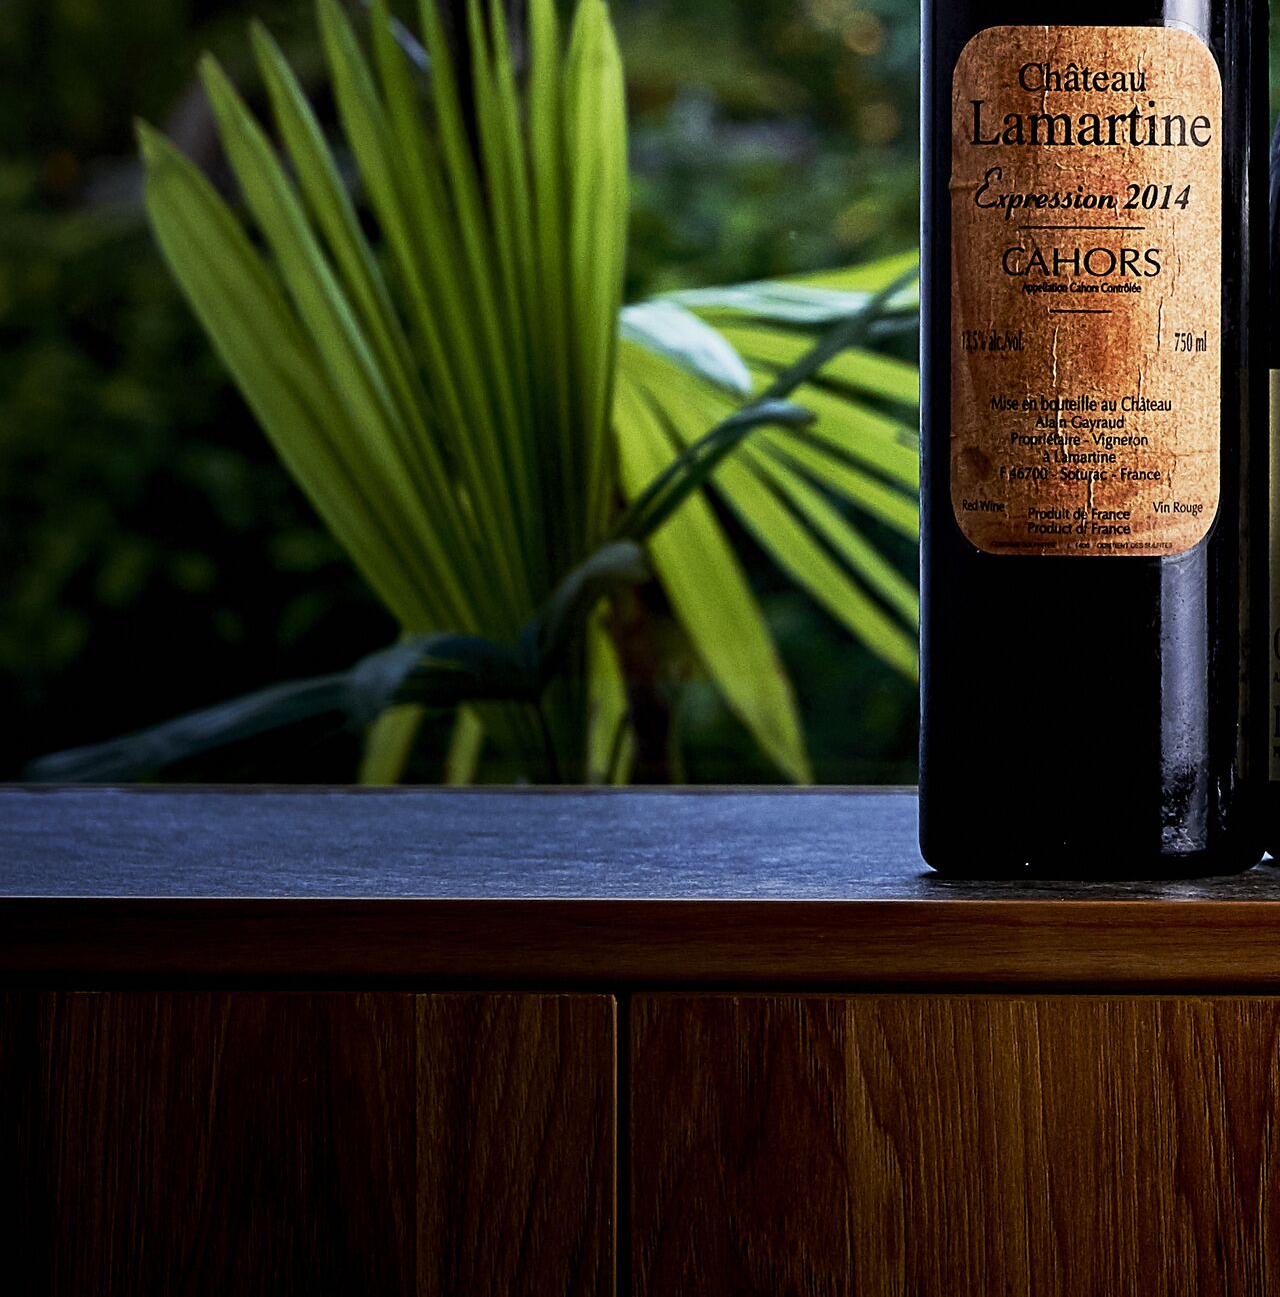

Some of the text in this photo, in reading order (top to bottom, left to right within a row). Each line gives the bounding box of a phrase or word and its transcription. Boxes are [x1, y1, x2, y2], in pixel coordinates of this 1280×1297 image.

[1019, 63, 1146, 92] Château
[970, 100, 1211, 146] Lamartine
[975, 167, 1191, 219] Expression 2014
[1002, 247, 1161, 277] CAHORS
[1022, 283, 1141, 294] Appellation Cahors Contrôlée
[1175, 331, 1207, 352] 750 ml
[992, 395, 1172, 411] Mise en bouteille au Château
[1036, 416, 1124, 431] Alain Gayraud
[1011, 433, 1081, 448] Propriétaire
[1092, 433, 1148, 448] Vigneron
[1043, 452, 1116, 463] à Lamartine
[1000, 469, 1006, 479] F
[1009, 469, 1047, 480] 46700
[1060, 469, 1107, 480] Soturac
[1120, 468, 1161, 480] France
[963, 500, 1004, 512] Red Wine
[1153, 501, 1203, 517] Vin Rouge
[1028, 508, 1130, 520] Produit de France
[1028, 522, 1130, 534] Product of France
